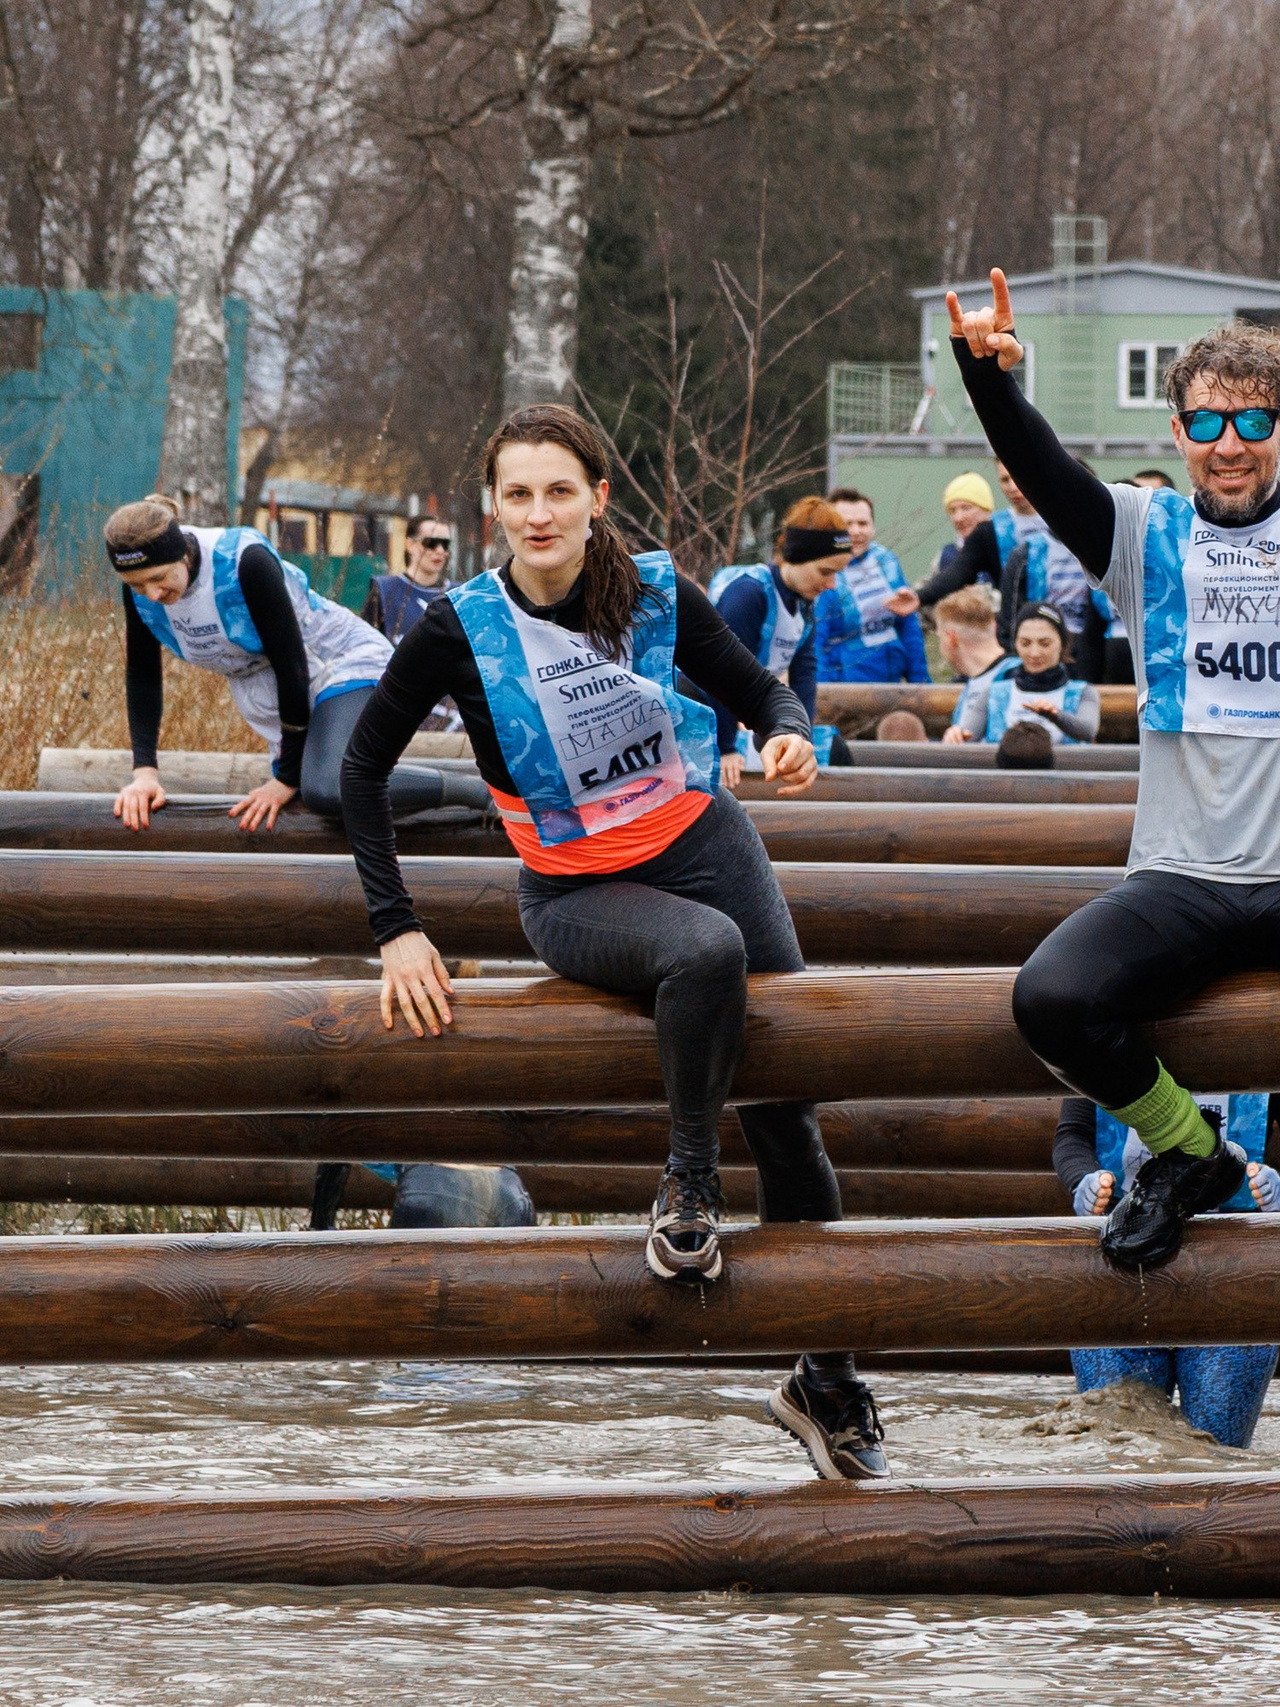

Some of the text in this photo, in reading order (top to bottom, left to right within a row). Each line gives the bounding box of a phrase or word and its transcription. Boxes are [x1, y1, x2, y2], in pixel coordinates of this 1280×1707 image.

[1206, 548, 1277, 568] Sminex
[1203, 575, 1279, 583] ПЕРФЕКЦИОНИСТЫ
[1223, 585, 1279, 593] DEVELOPMENT
[537, 656, 584, 679] ГОНКА
[558, 673, 637, 705] Sminex
[571, 696, 642, 730] FINE DEVELOPMENT
[1223, 708, 1280, 719] ГАЗПРОМБАНК
[568, 699, 668, 757] МАША
[579, 730, 663, 791] 5407
